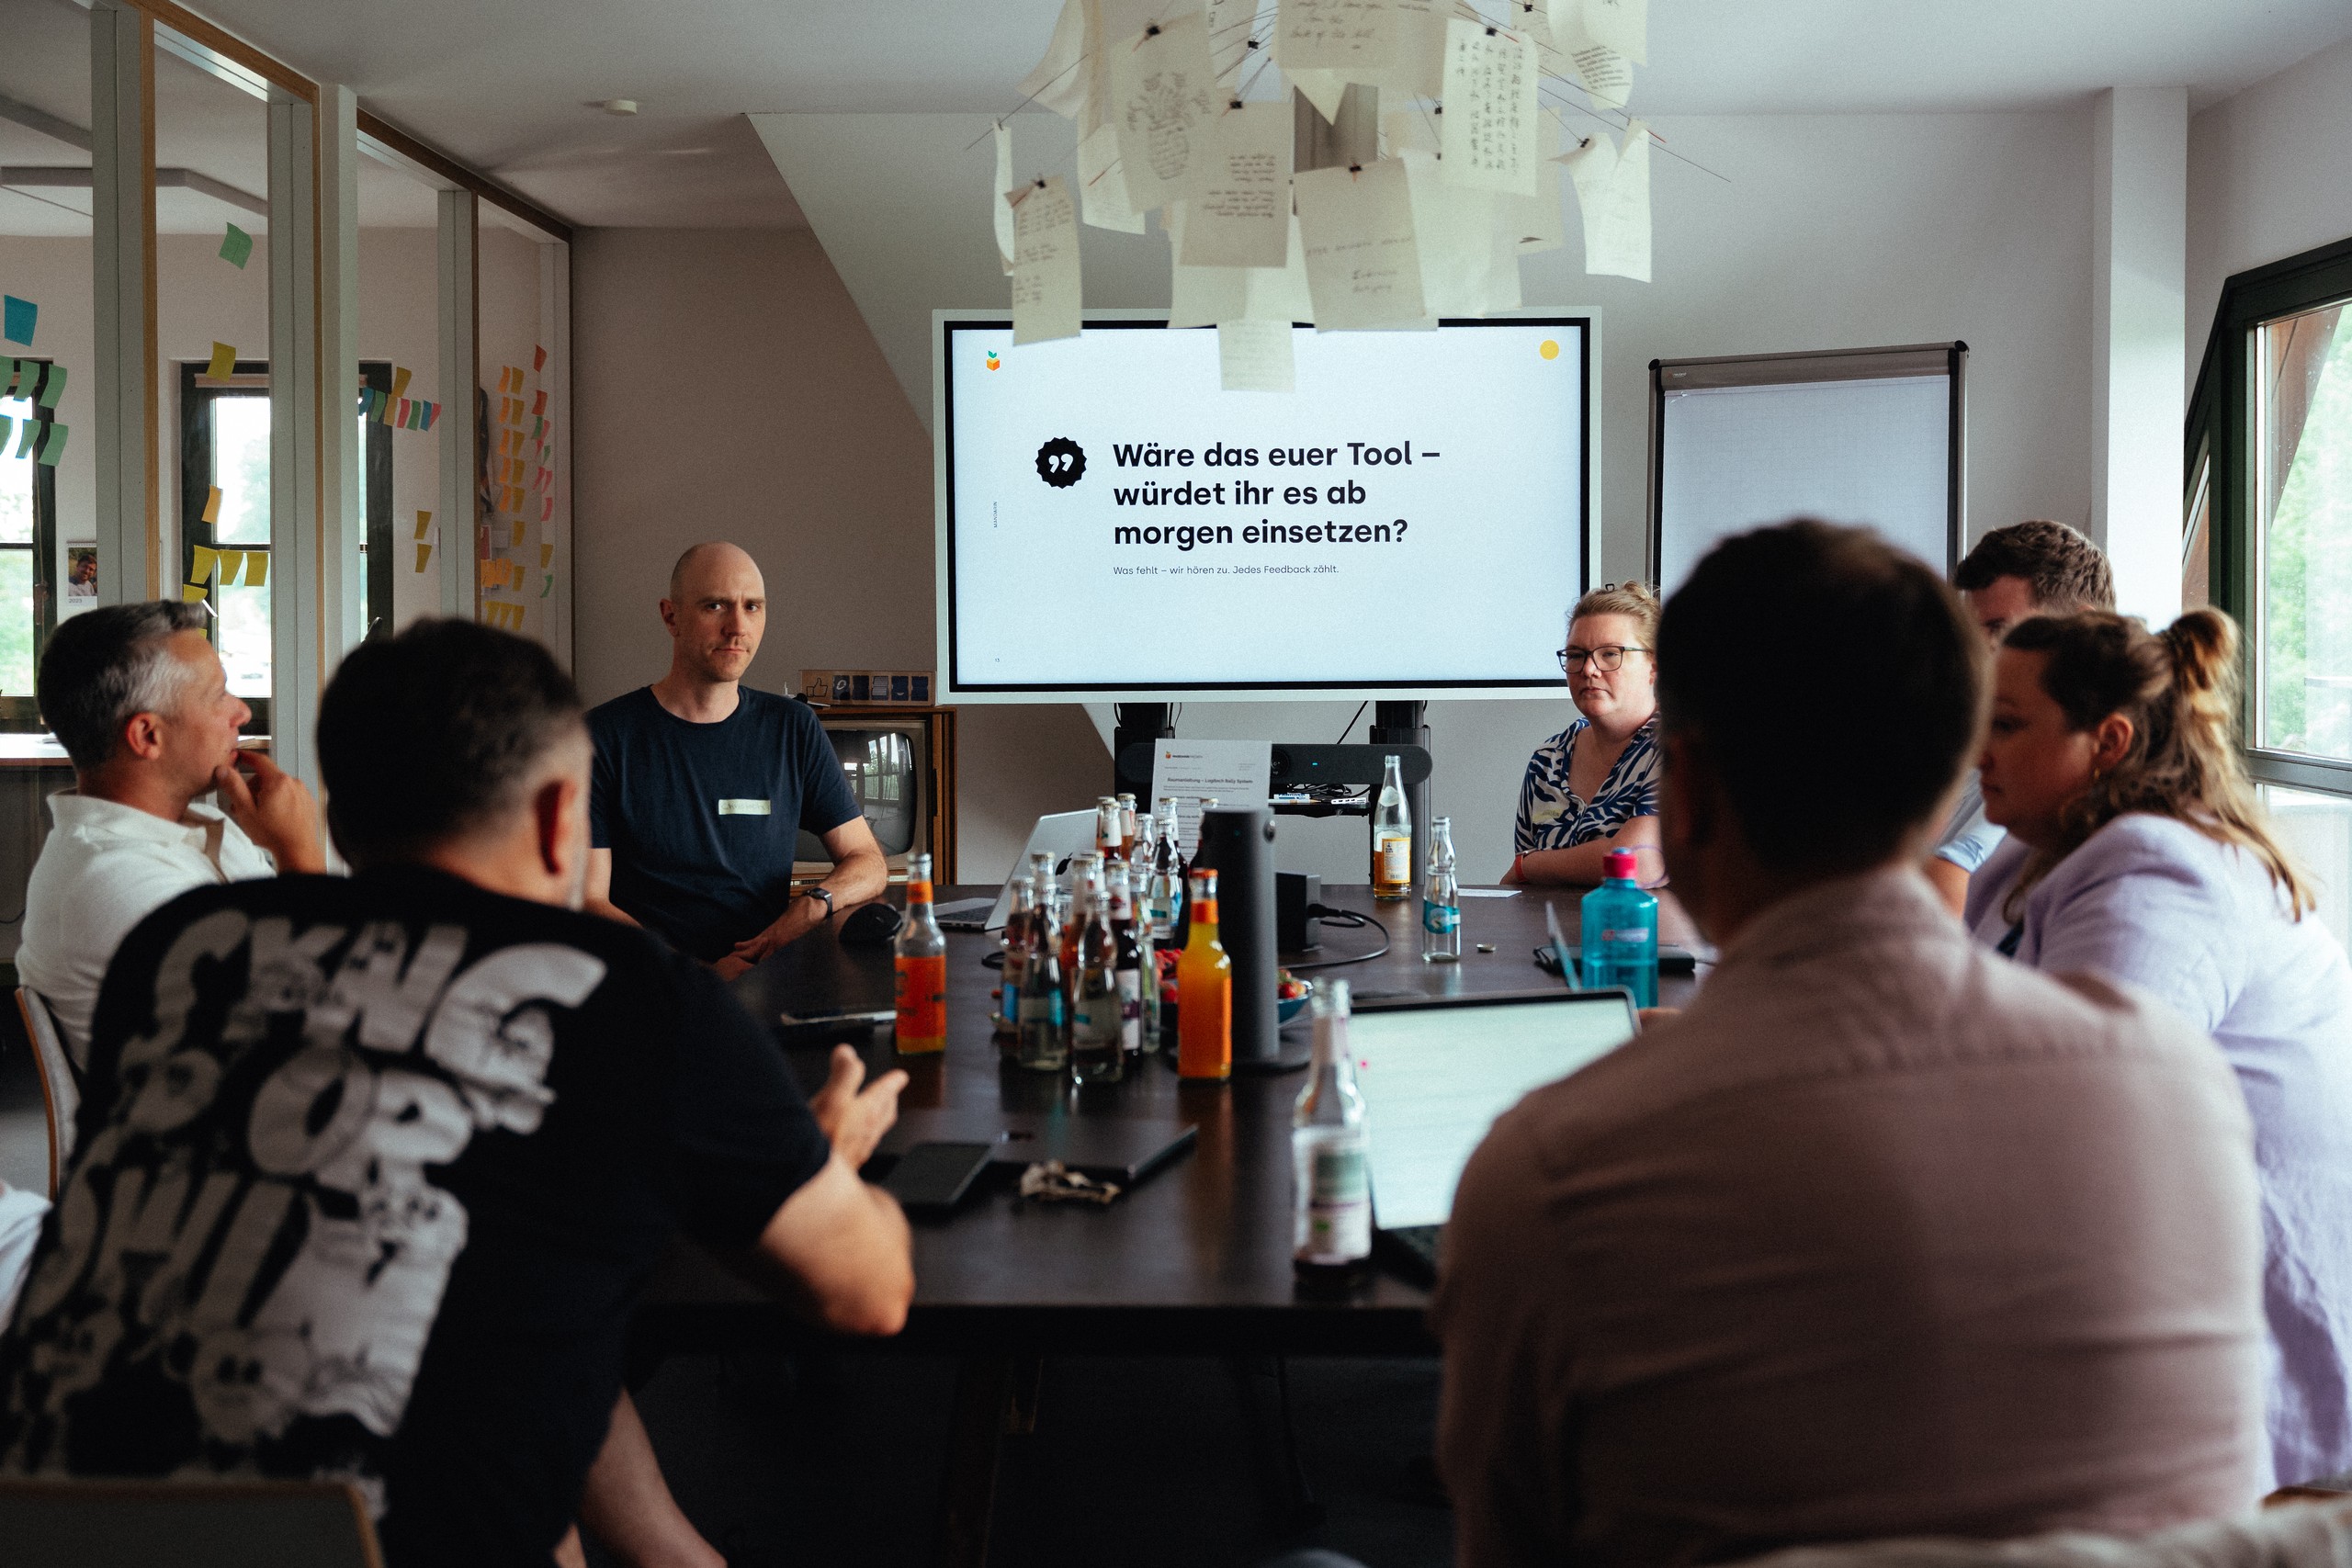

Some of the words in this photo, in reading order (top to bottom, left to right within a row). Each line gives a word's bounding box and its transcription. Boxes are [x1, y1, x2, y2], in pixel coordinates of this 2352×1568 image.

[1113, 442, 1195, 468] Wäre
[1204, 441, 1260, 468] das
[1268, 447, 1339, 467] euer
[1347, 440, 1412, 466] Tool
[1113, 480, 1226, 506] würdet
[1235, 479, 1274, 505] ihr
[1283, 486, 1318, 505] es
[1327, 479, 1366, 505] ab
[1114, 525, 1233, 552] morgen
[1242, 518, 1408, 544] einsetzen?
[1113, 566, 1134, 575] Was
[1136, 566, 1159, 575] fehlt
[1169, 566, 1184, 574] wir
[1186, 566, 1215, 574] hören
[1232, 565, 1261, 574] Jedes
[1263, 565, 1311, 574] Feedback
[1313, 564, 1340, 573] zählt.
